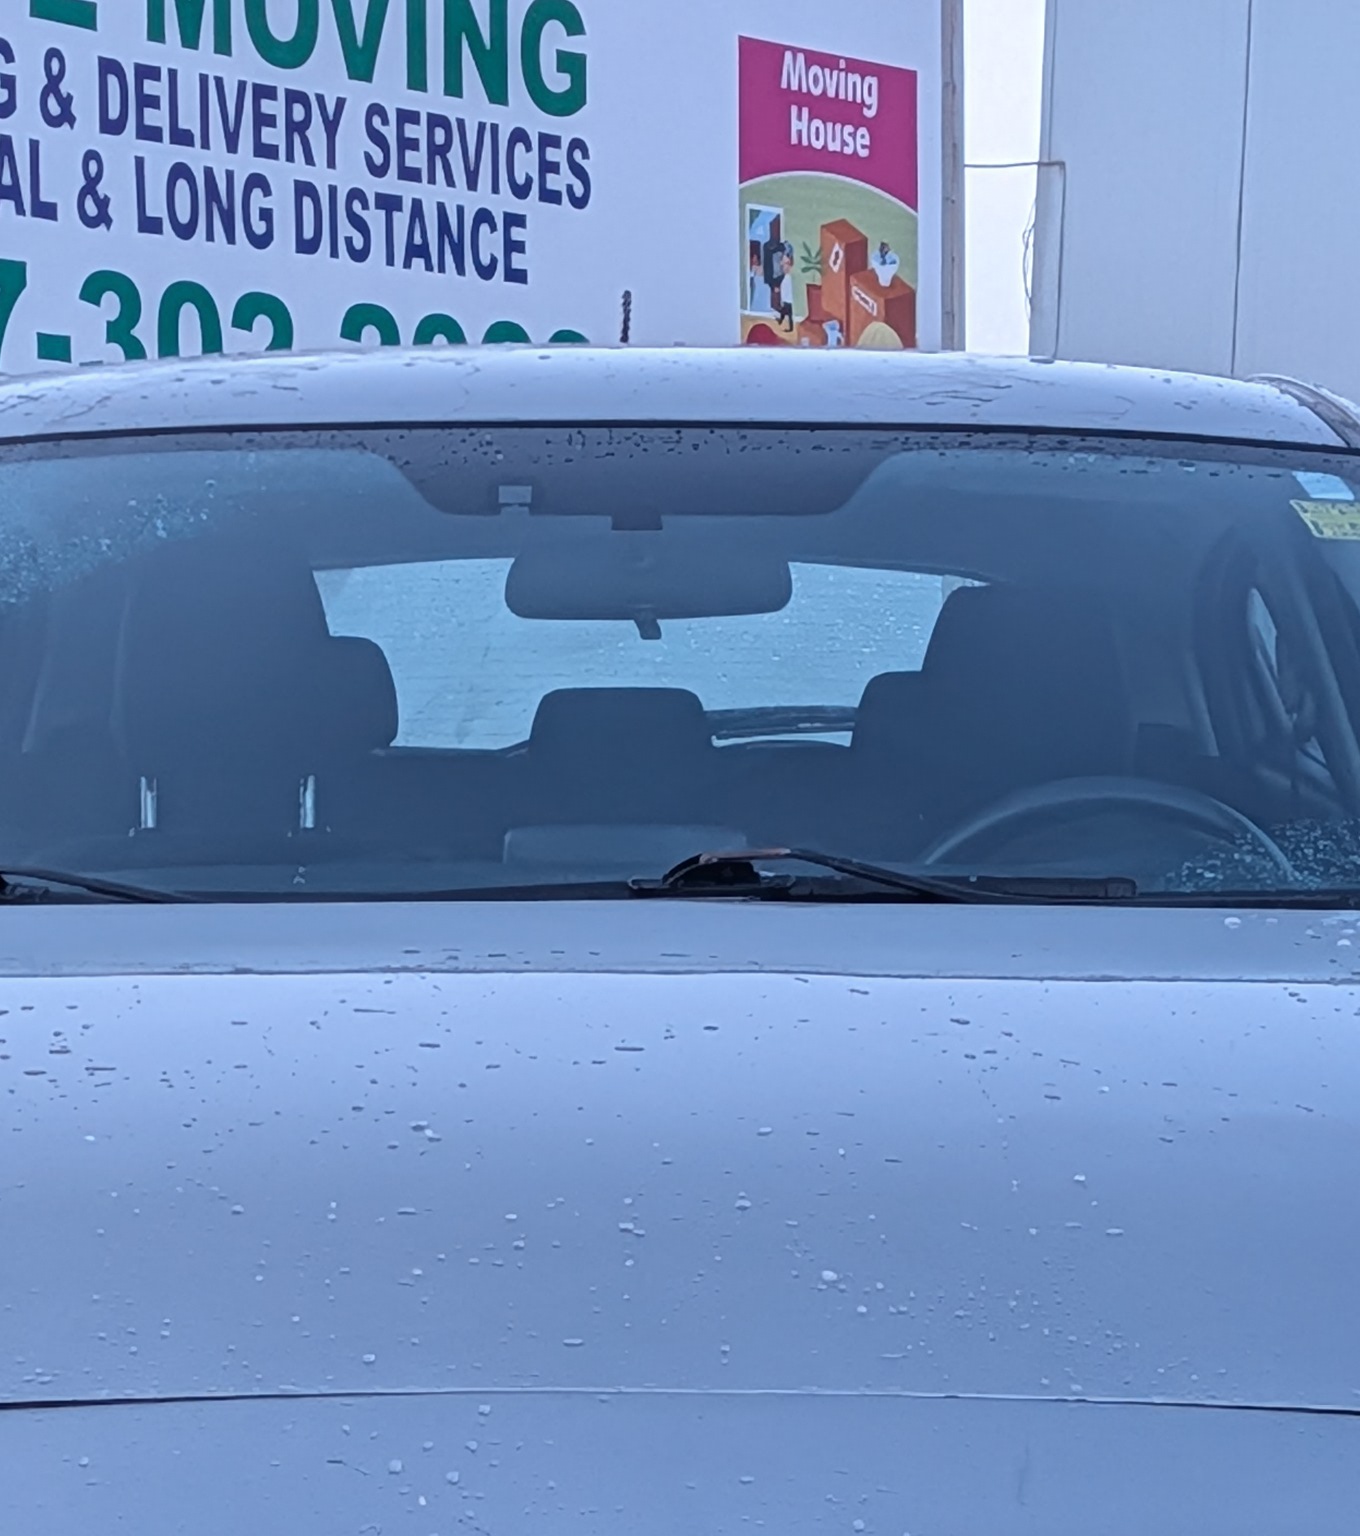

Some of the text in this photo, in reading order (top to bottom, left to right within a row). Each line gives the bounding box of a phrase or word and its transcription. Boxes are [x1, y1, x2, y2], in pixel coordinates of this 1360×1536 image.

[39, 47, 77, 130] &
[97, 56, 346, 170] DELIVERY
[363, 102, 592, 209] SERVICES
[780, 50, 879, 118] Moving
[790, 105, 871, 158] House
[76, 149, 114, 232] &
[134, 155, 274, 250] LONG
[294, 181, 529, 286] DISTANCE
